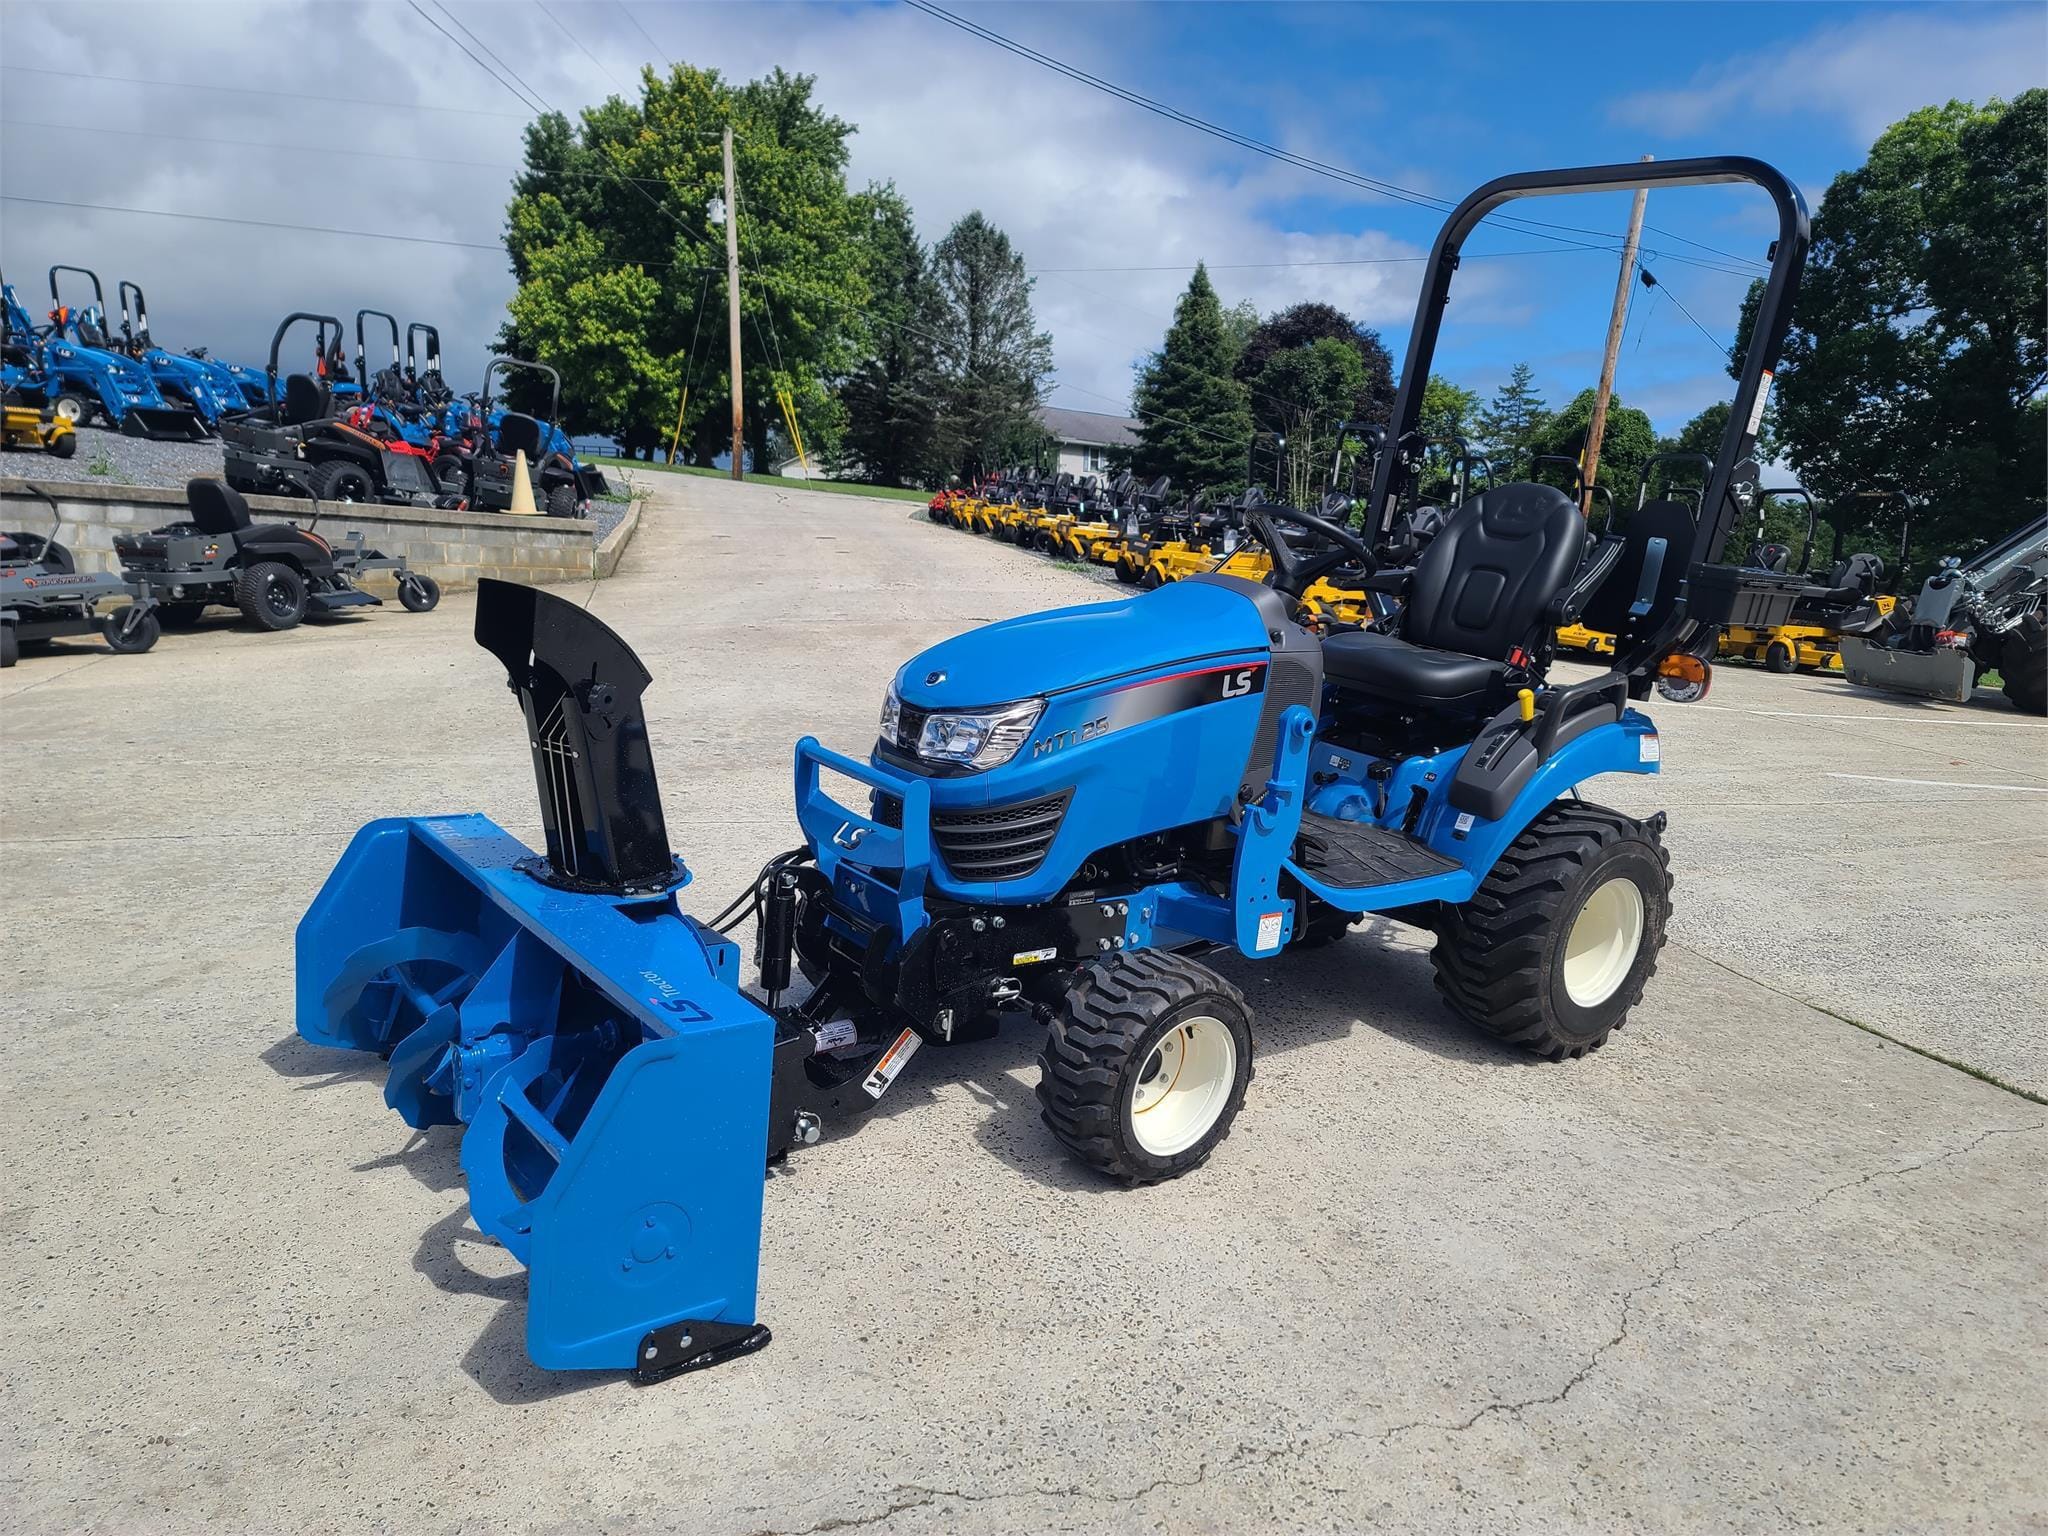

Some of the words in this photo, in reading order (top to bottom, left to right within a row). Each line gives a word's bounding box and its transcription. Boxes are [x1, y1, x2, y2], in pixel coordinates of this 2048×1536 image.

[1222, 671, 1252, 698] LS
[832, 820, 868, 851] LS
[639, 968, 680, 998] Tractor
[659, 999, 715, 1023] LS
